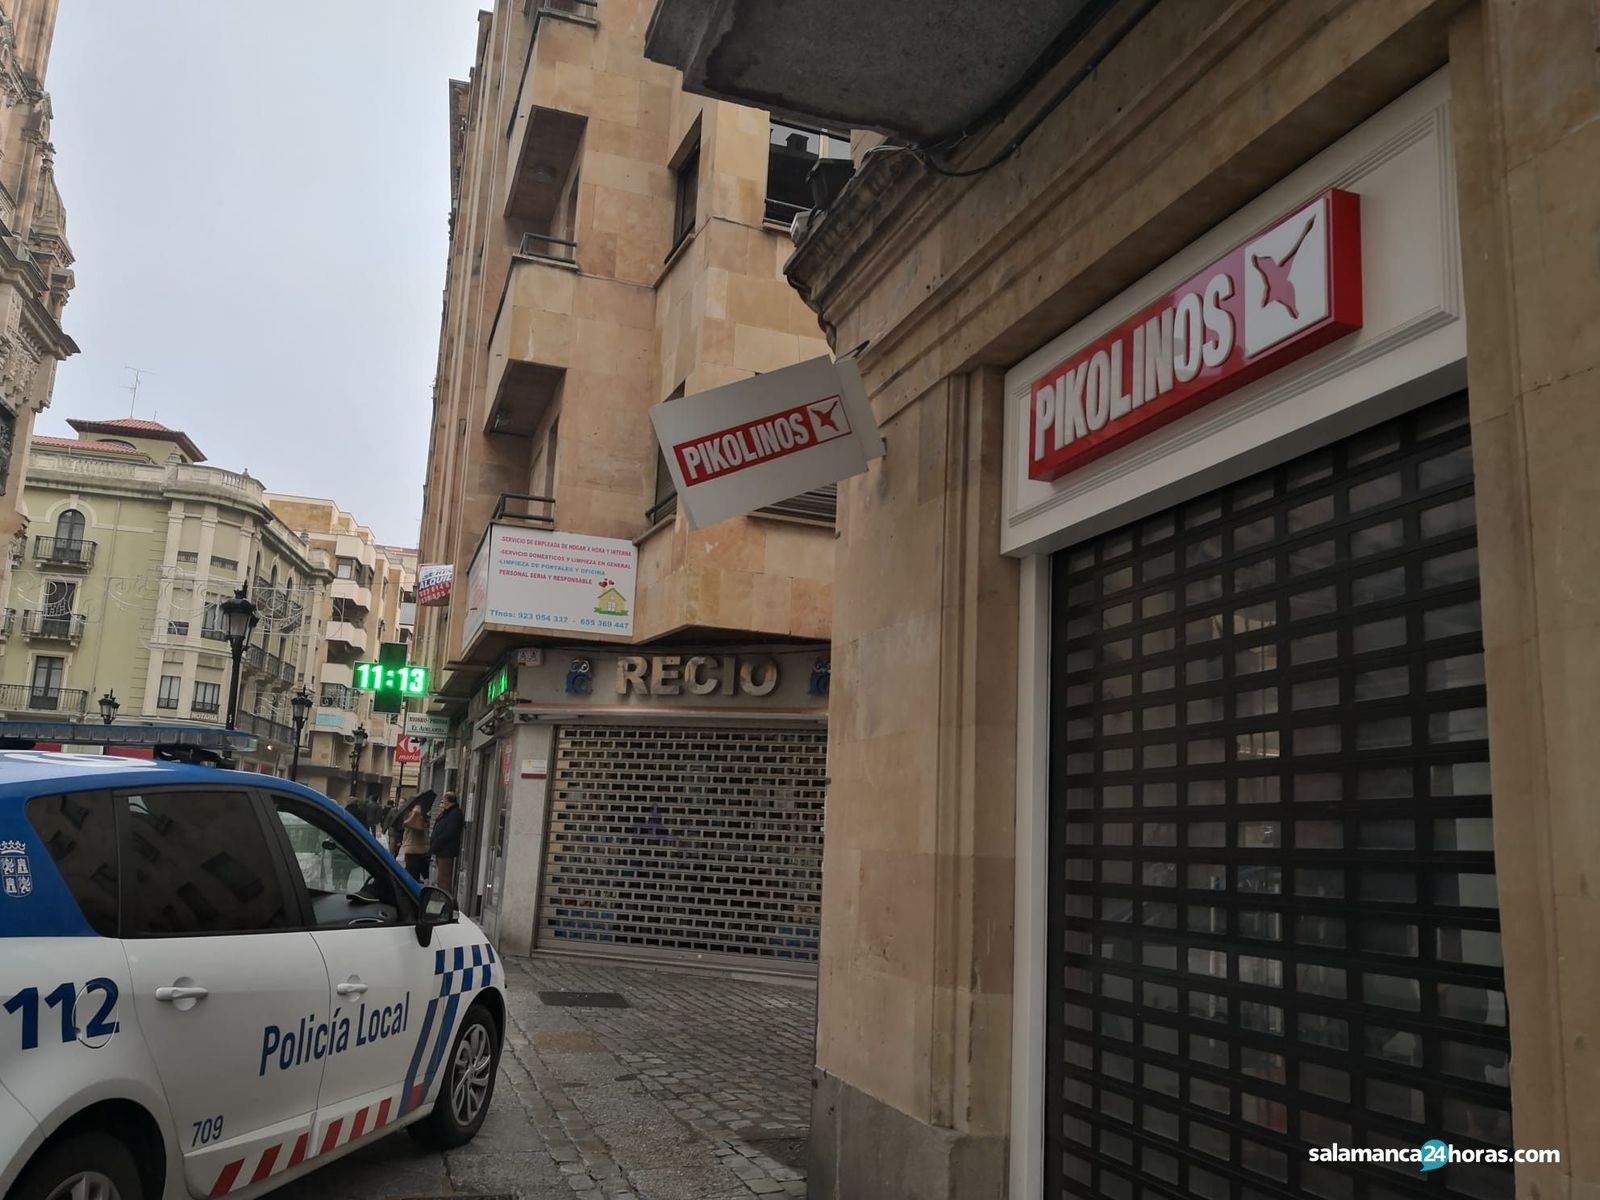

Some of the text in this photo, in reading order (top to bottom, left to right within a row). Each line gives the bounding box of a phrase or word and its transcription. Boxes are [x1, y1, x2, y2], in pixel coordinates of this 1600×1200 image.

[1035, 273, 1234, 462] PIKOLINOS
[682, 412, 810, 480] PIKOLINOS
[535, 540, 560, 548] EMPLEADA
[529, 552, 565, 561] DOMESTICOS
[571, 557, 597, 565] LIMPIEZA
[606, 562, 631, 570] GENERAL
[541, 564, 573, 572] PORTALES
[580, 568, 606, 576] OFICINA
[499, 569, 529, 578] PERSONAL
[530, 572, 547, 580] SERIA
[553, 575, 593, 585] RESPONSABLE
[518, 611, 534, 620] 923
[580, 618, 595, 626] 655
[613, 622, 629, 630] 447
[357, 664, 425, 692] 11:13
[616, 655, 779, 697] RECIO
[2, 977, 121, 1050] 112
[259, 992, 410, 1076] Policía Local
[191, 1115, 224, 1147] 709
